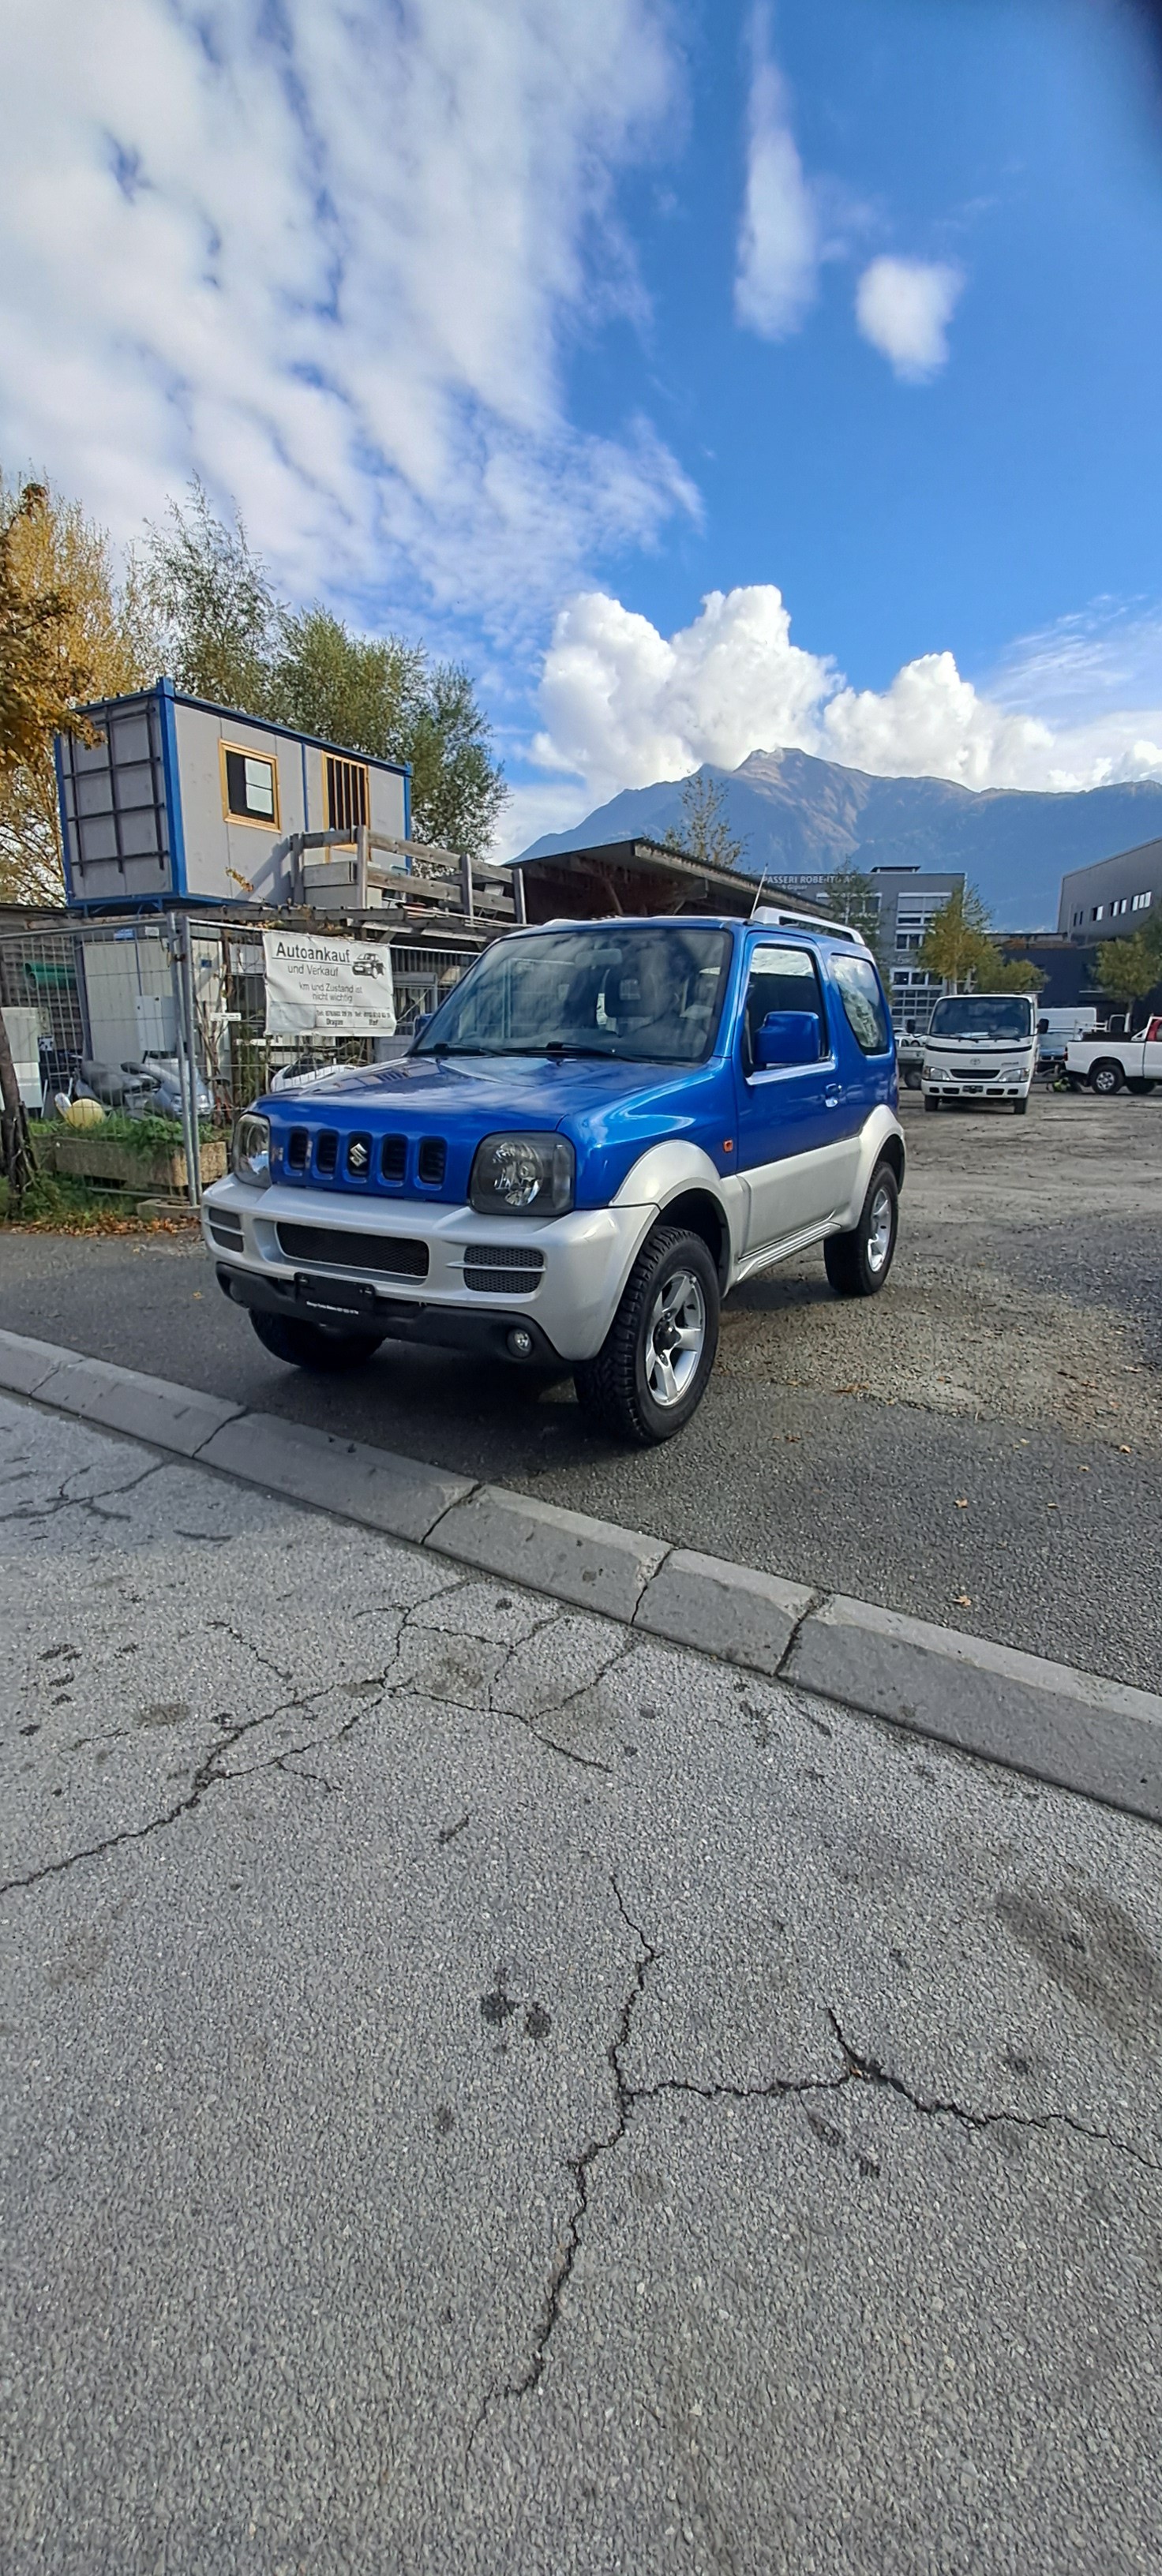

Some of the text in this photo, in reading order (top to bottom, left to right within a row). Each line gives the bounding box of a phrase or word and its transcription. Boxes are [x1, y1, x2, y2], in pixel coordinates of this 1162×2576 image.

[763, 875, 797, 884] PASSERI
[276, 942, 350, 963] Autoankauf
[287, 964, 339, 977] und Verkauf
[298, 982, 310, 990] km
[311, 983, 324, 991] und
[325, 983, 354, 993] Zustand
[330, 994, 353, 1003] wichtig
